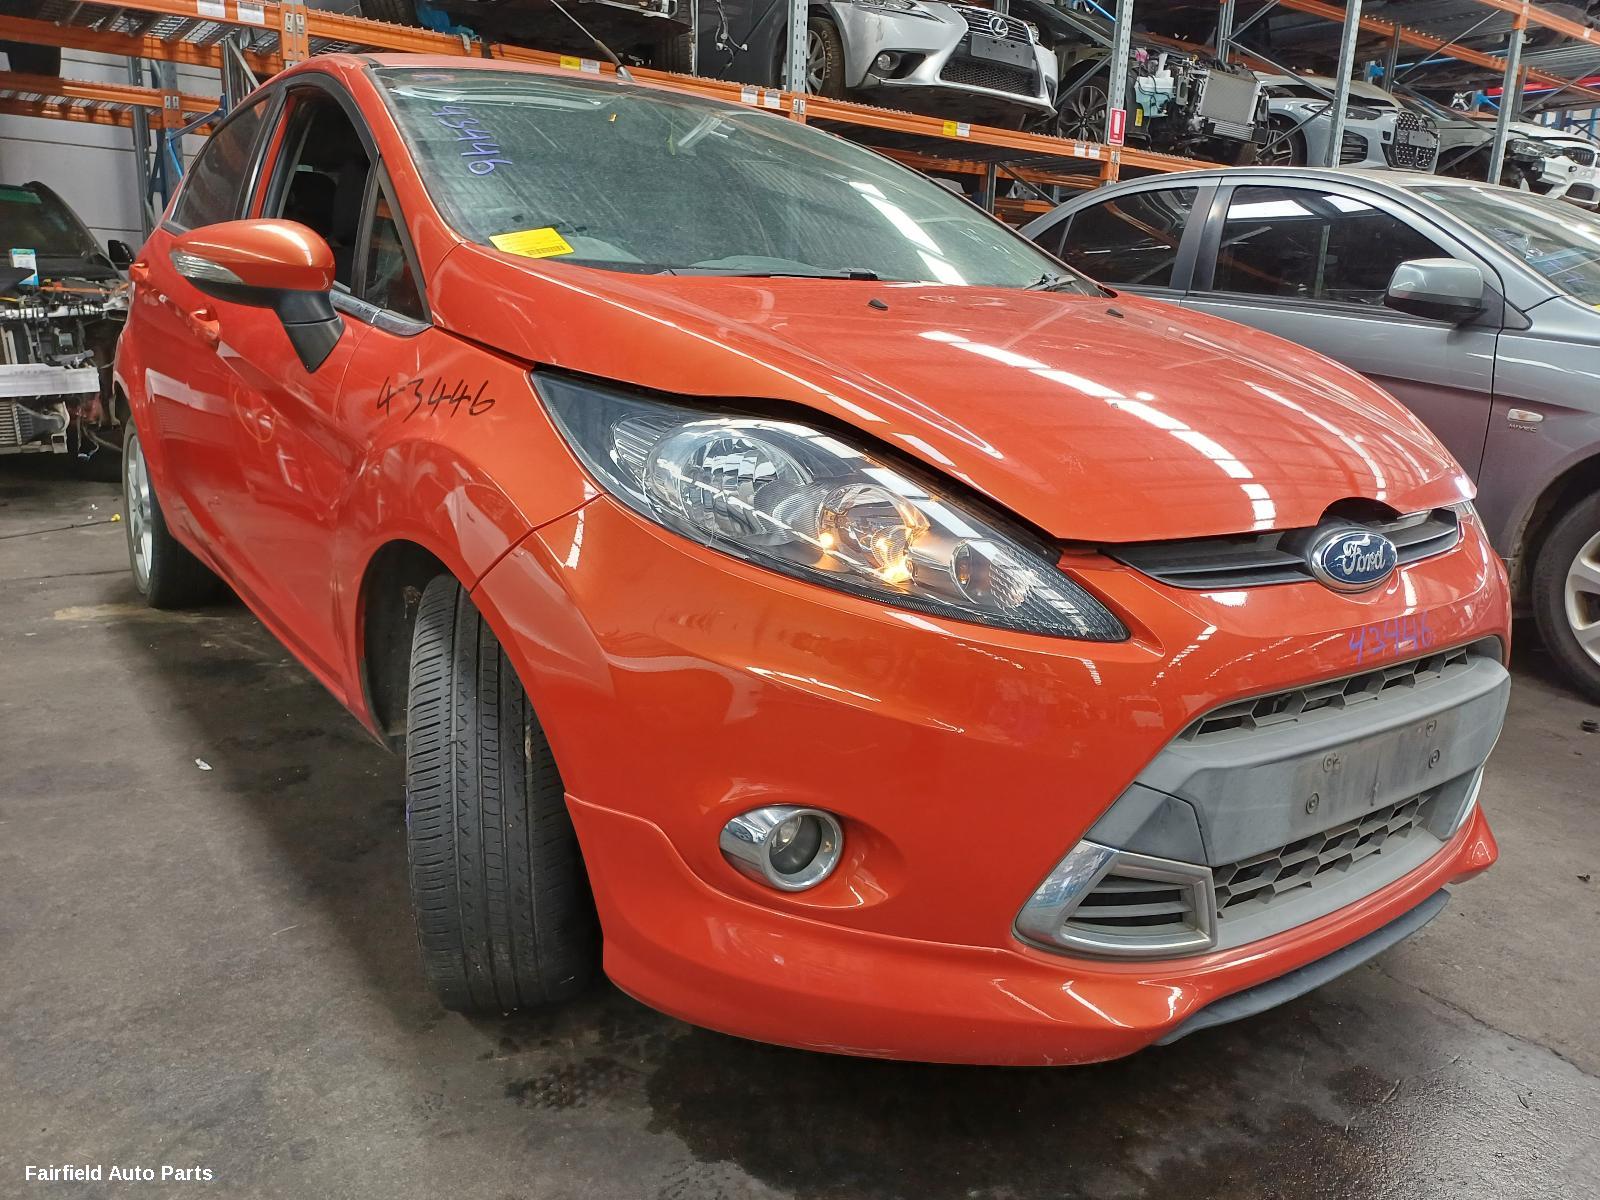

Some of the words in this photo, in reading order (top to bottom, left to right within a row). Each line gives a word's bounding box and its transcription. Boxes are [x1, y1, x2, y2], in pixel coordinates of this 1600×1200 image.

[376, 376, 496, 423] 43446
[1334, 533, 1387, 576] Ford
[1348, 609, 1433, 665] 43446
